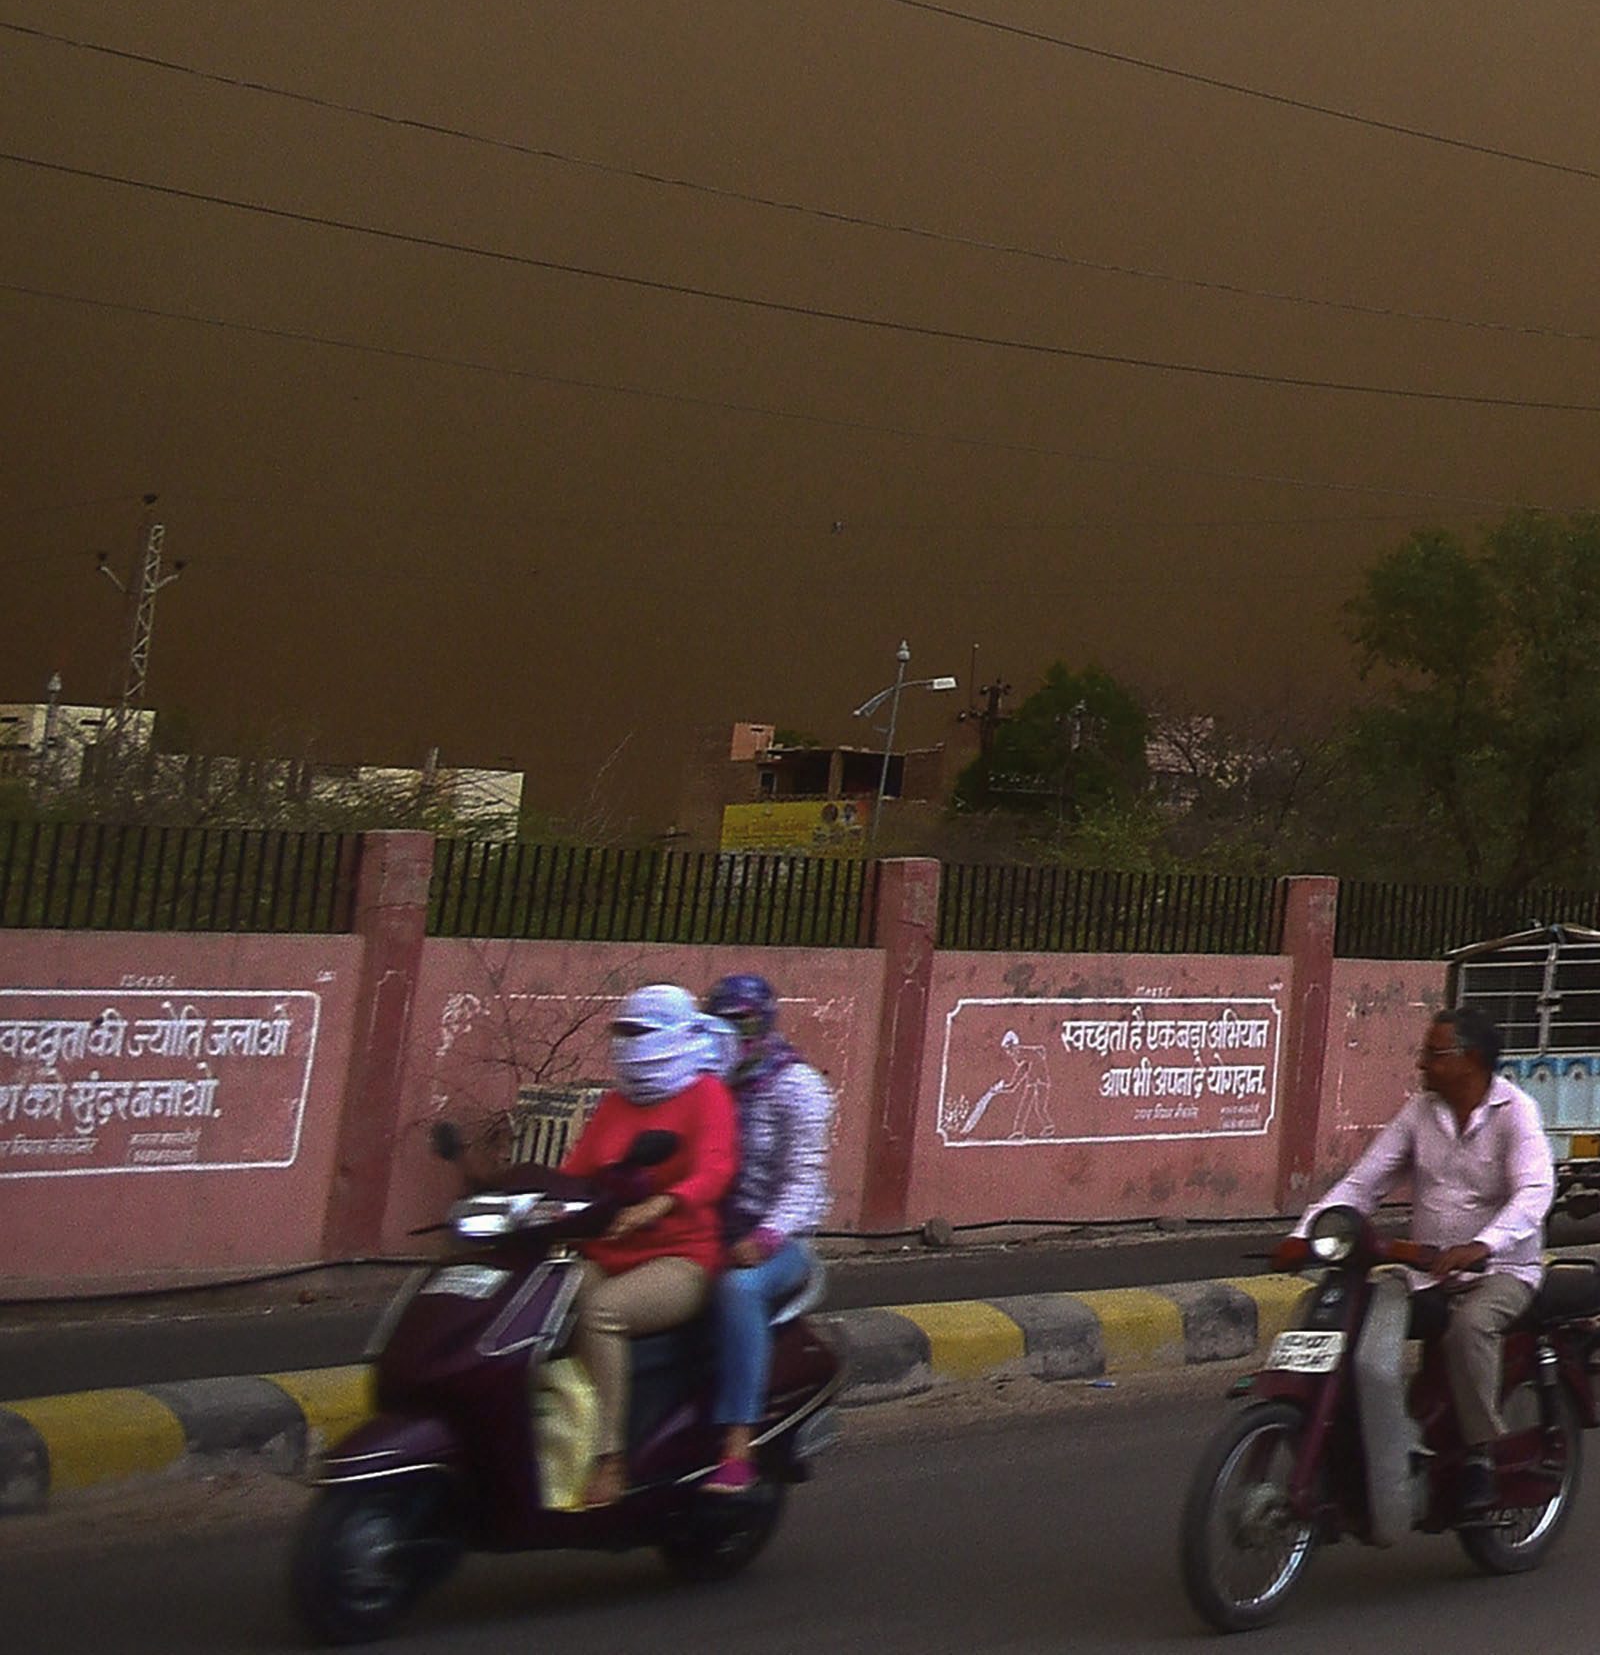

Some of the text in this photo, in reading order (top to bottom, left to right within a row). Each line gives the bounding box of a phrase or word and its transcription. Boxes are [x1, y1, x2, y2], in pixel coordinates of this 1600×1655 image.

[0, 1002, 292, 1067] वच्छता की ज्योति जलाओ
[1061, 1020, 1128, 1057] स्वच्छता
[1130, 1005, 1146, 1054] है
[1147, 1020, 1176, 1051] एक
[1208, 1008, 1269, 1050] अभियान
[23, 1066, 67, 1121] को
[70, 1071, 133, 1134] सुंदर
[1100, 1066, 1132, 1097] आप
[1133, 1057, 1153, 1097] भी
[1153, 1066, 1193, 1097] अपना
